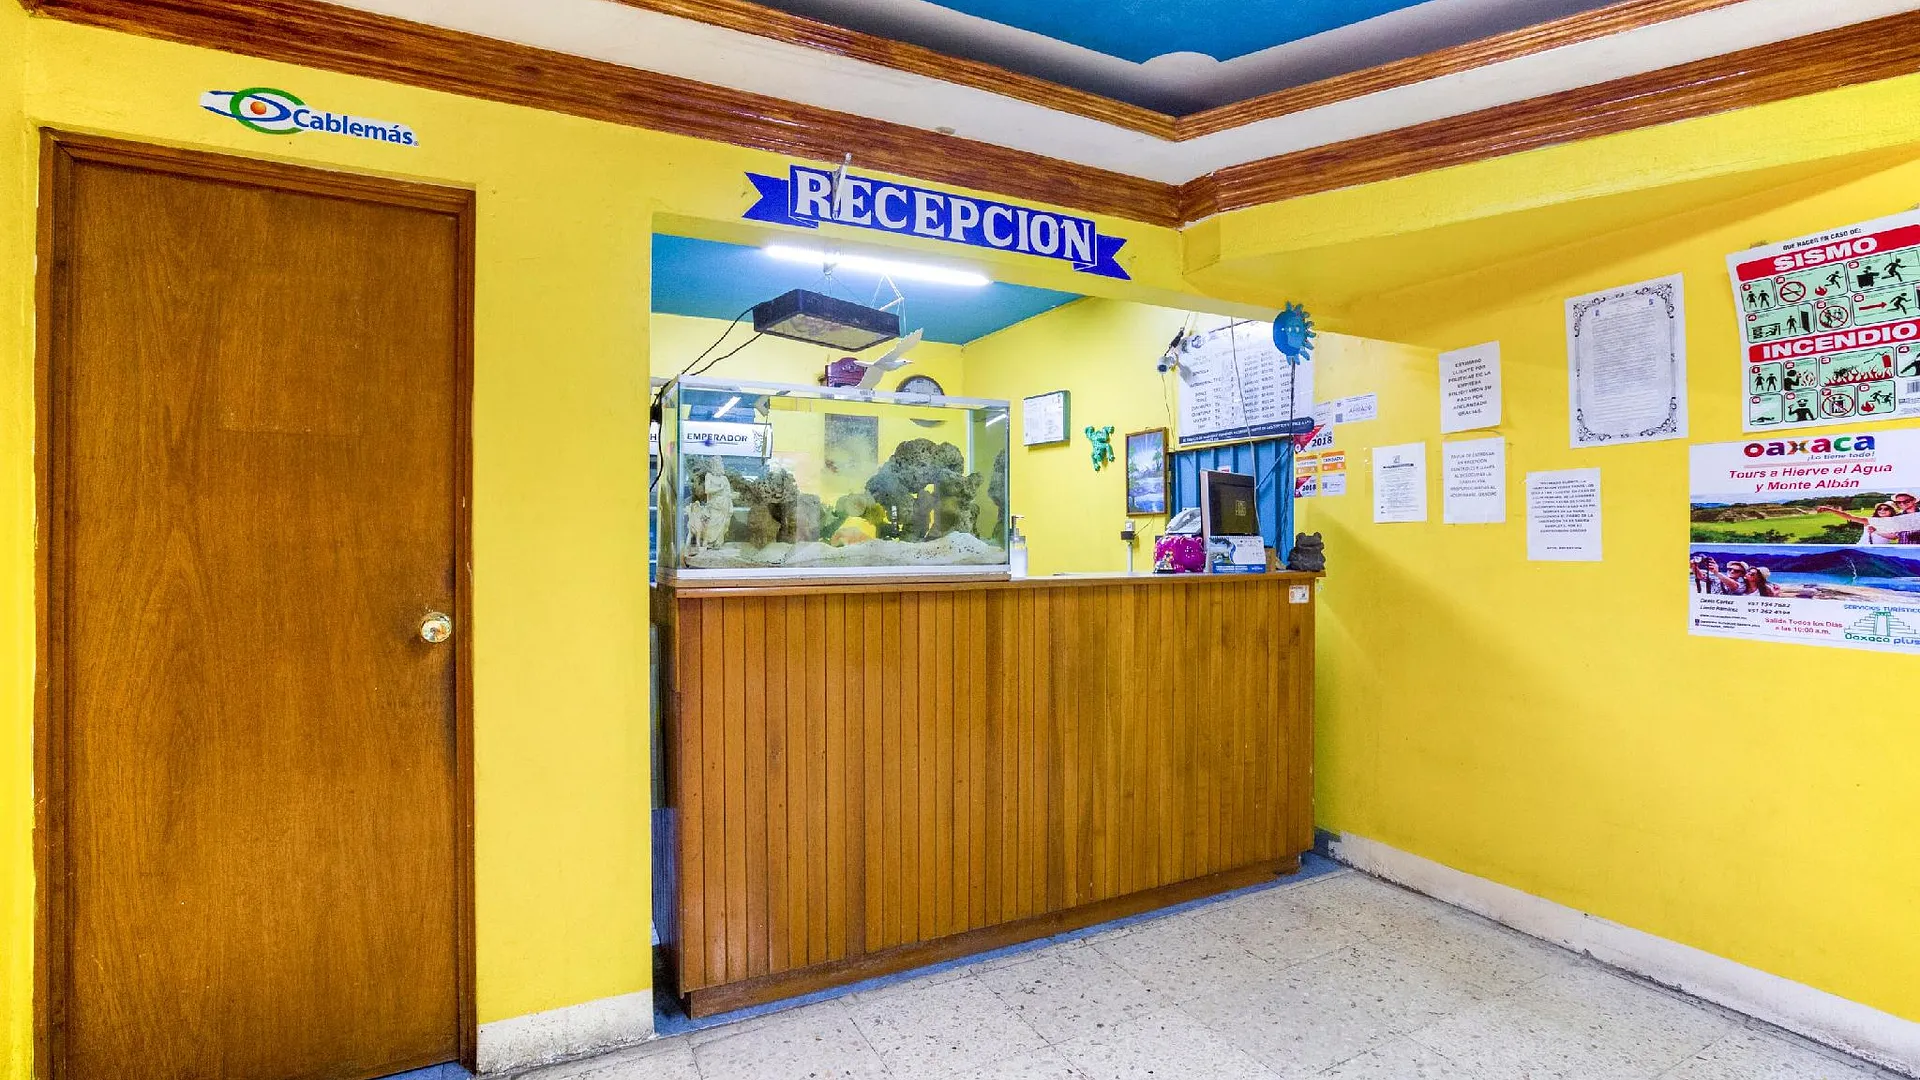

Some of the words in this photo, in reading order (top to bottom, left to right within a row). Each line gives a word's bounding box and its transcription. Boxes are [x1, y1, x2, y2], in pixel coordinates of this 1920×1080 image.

[293, 109, 414, 146] Cablemás
[794, 170, 1095, 263] RECEPCION
[1831, 231, 1848, 239] CASO
[1773, 238, 1878, 272] SISMO
[1762, 323, 1918, 360] INCENDIO
[687, 432, 748, 442] EMPERADOR
[1312, 436, 1332, 448] 2018
[1744, 435, 1876, 458] oaxaca
[1729, 470, 1766, 479] Tours
[1782, 467, 1830, 477] Hierve
[1834, 464, 1847, 474] el
[1851, 463, 1893, 476] Agua
[1755, 483, 1763, 494] y
[1768, 480, 1812, 490] Monte
[1815, 478, 1860, 489] Albán
[1845, 632, 1890, 642] Oaxaca
[1894, 637, 1920, 645] plus
